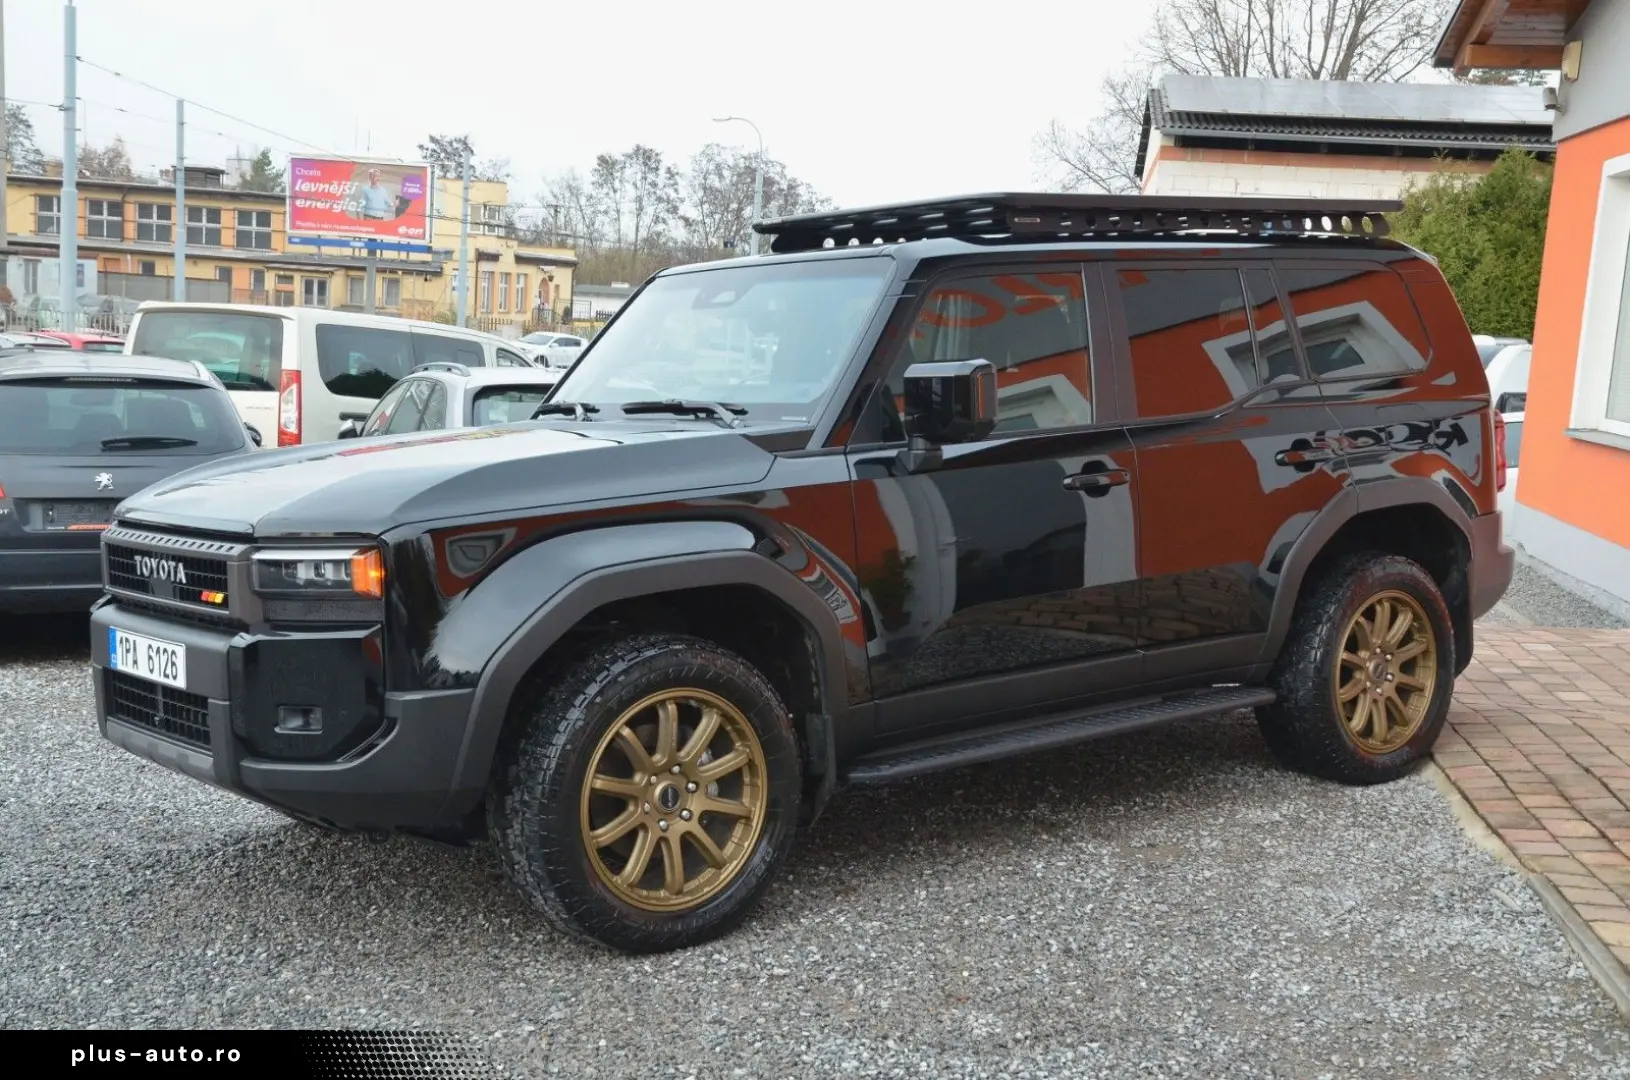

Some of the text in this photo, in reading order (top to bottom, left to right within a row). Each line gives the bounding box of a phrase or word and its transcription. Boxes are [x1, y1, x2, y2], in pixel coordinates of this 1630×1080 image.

[295, 179, 359, 197] levnější
[295, 197, 366, 213] energie?
[134, 555, 187, 584] TOYOTA
[119, 636, 178, 681] 1PA 6126
